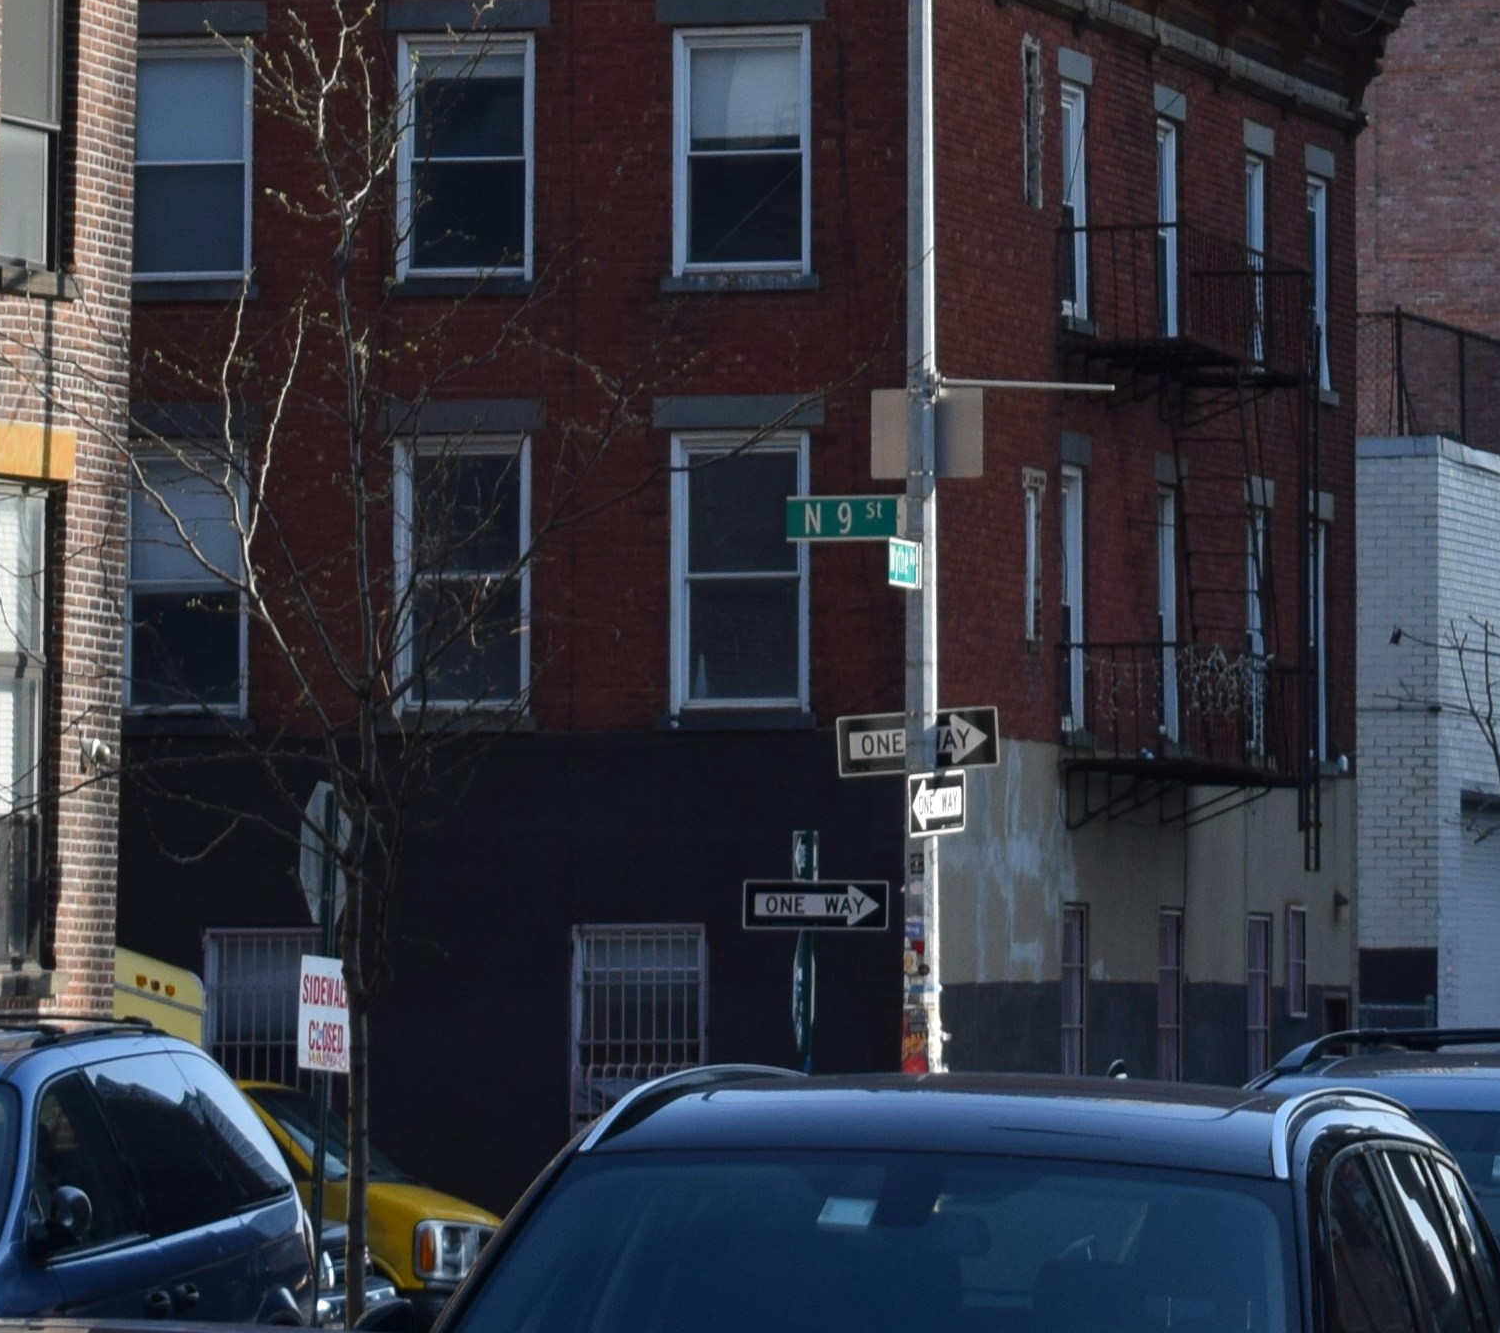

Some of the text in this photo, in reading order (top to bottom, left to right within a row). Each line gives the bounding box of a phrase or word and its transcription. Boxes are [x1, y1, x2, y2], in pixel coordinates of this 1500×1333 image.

[804, 501, 883, 535] N 9 St
[861, 727, 972, 756] ONE AY
[918, 789, 959, 815] ONE WAY
[765, 896, 866, 915] ONE WAY
[302, 973, 349, 1009] SIDEWAL
[308, 1019, 344, 1054] CLOSED
